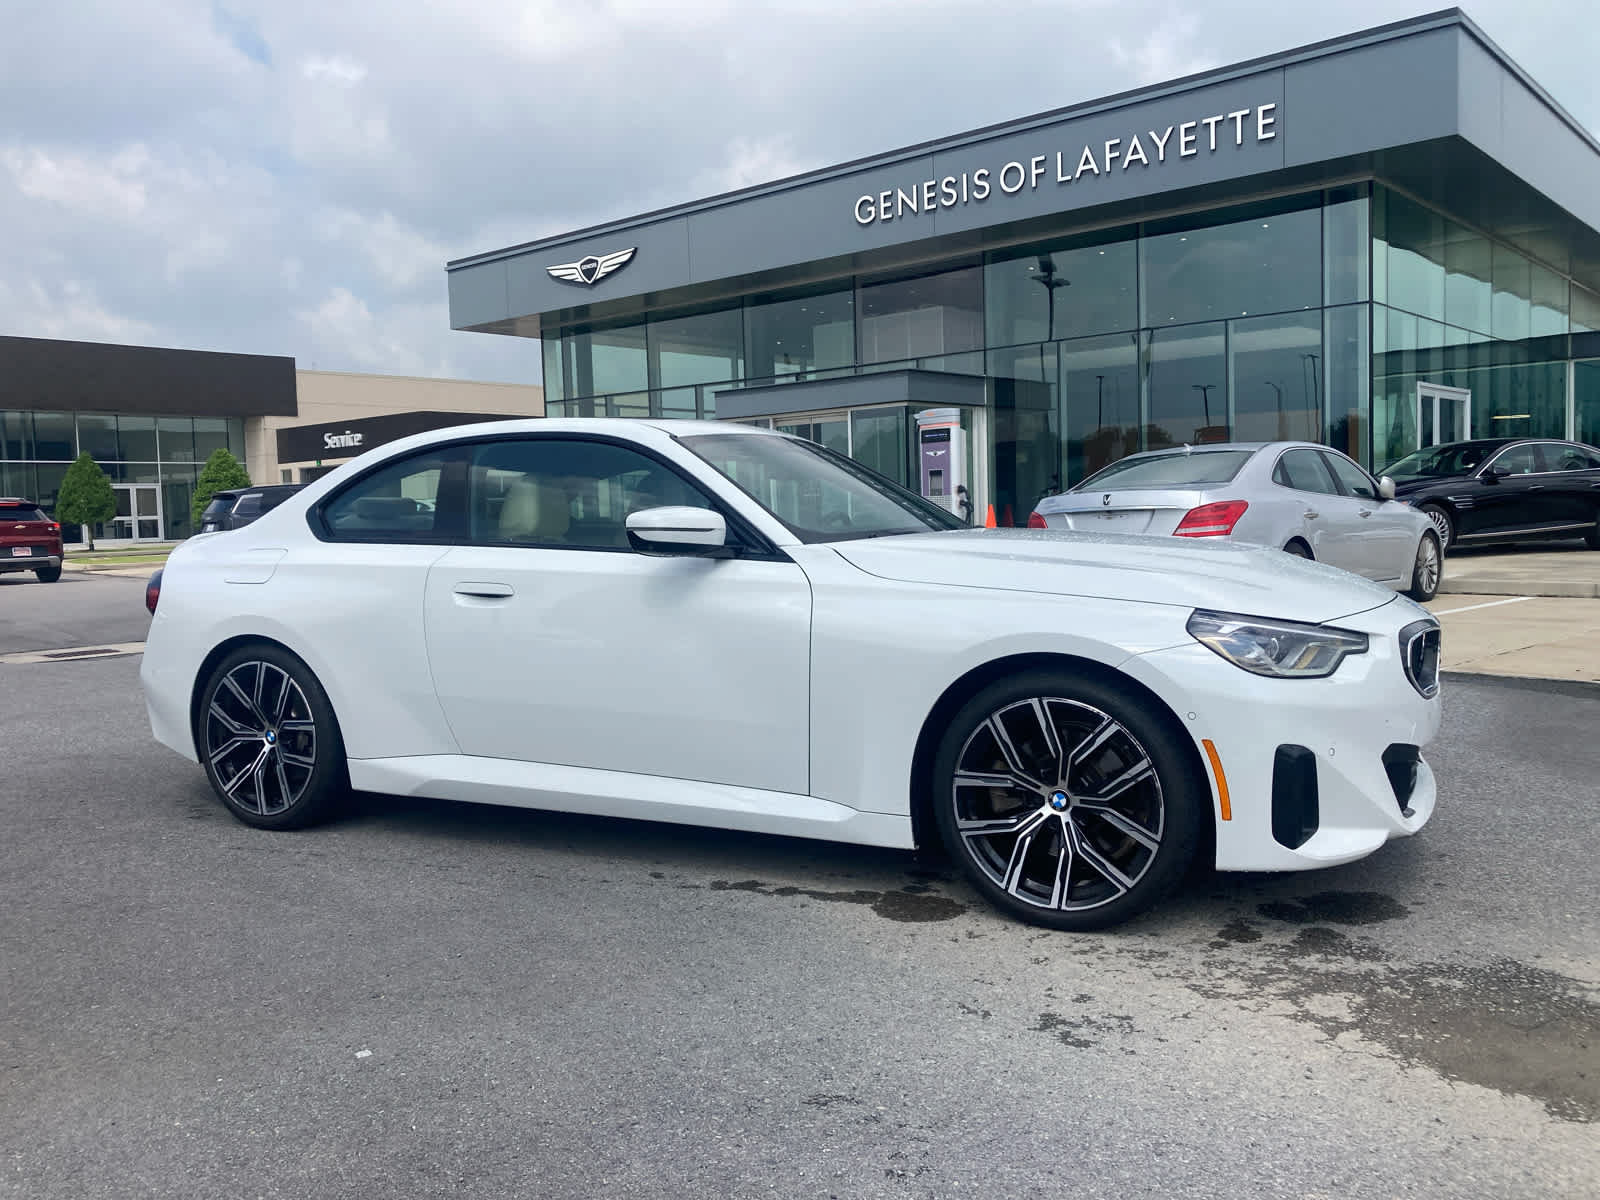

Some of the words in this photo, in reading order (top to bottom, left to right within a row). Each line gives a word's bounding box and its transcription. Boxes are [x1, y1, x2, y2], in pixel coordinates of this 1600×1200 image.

[854, 168, 990, 225] GENESIS
[999, 155, 1046, 193] OF
[1056, 103, 1277, 183] LAFAYETTE
[324, 430, 363, 449] Service
